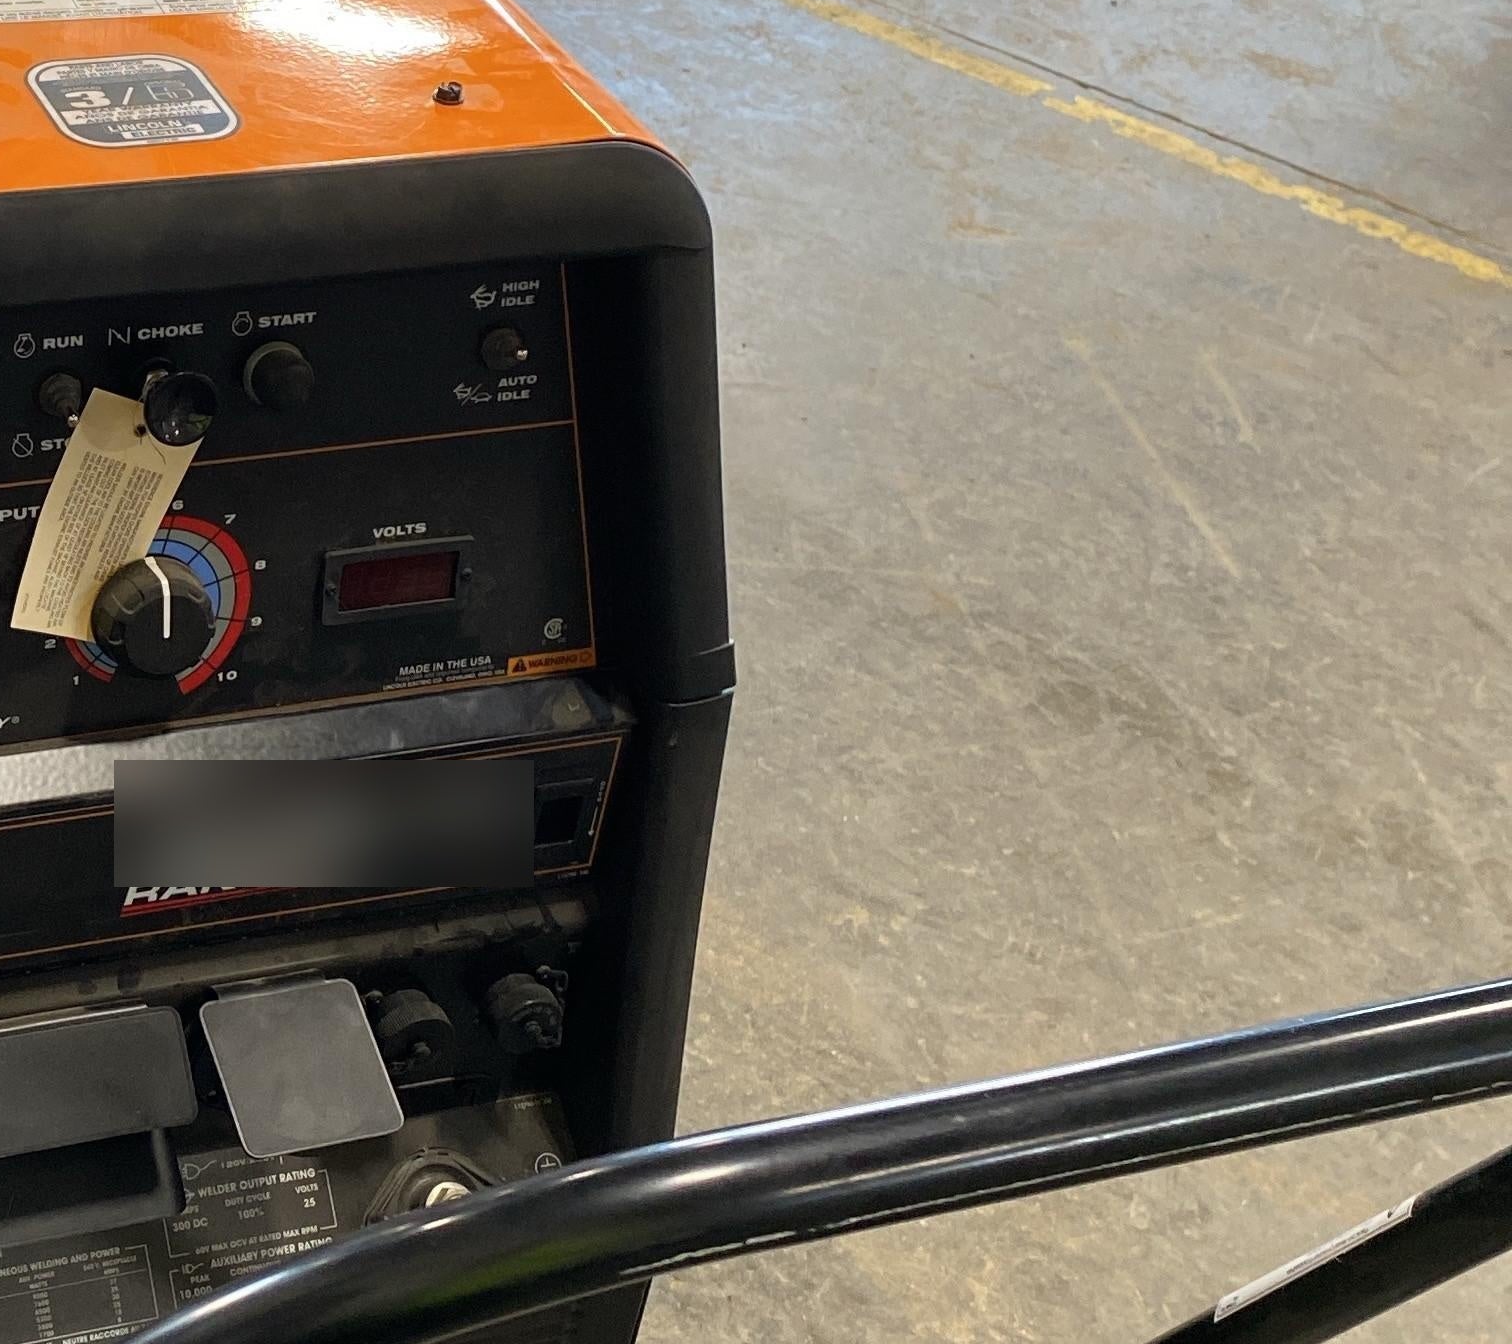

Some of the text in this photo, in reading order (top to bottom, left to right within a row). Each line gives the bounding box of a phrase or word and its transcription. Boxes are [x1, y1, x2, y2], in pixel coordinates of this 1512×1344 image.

[64, 89, 112, 109] 3
[107, 119, 183, 133] LINCOLN
[131, 127, 198, 138] ELECTRIC
[502, 279, 540, 293] HIGH
[500, 295, 536, 307] IDLE
[257, 311, 317, 329] START
[137, 323, 205, 341] CHOKE
[42, 335, 84, 351] RUN
[497, 375, 538, 388] AUTO
[497, 389, 531, 402] IDLE
[40, 437, 70, 452] STO
[172, 499, 184, 511] 6
[223, 513, 237, 525] 7
[372, 522, 428, 539] VOLTS
[254, 559, 267, 571] 8
[250, 616, 263, 627] 9
[44, 638, 57, 650] 2
[399, 663, 429, 676] MADE
[430, 662, 445, 673] IN
[446, 659, 468, 671] THE
[469, 655, 492, 668] USA
[527, 653, 578, 668] WARNING
[72, 674, 80, 686] 1
[216, 670, 238, 682] 10
[198, 1167, 316, 1199] WELDER OUTPUT RATING
[294, 1183, 319, 1195] VOLTS
[245, 1191, 272, 1203] CYCLE
[303, 1197, 316, 1208] 25
[172, 1217, 209, 1233] 300 DC
[283, 1228, 300, 1239] MAX
[301, 1225, 318, 1236] RPM
[30, 1256, 70, 1272] WELDING
[70, 1253, 89, 1265] AND
[89, 1246, 121, 1261] POWER
[210, 1249, 258, 1269] AUXILIARY
[260, 1243, 296, 1258] POWER
[189, 1274, 211, 1285] PEAK
